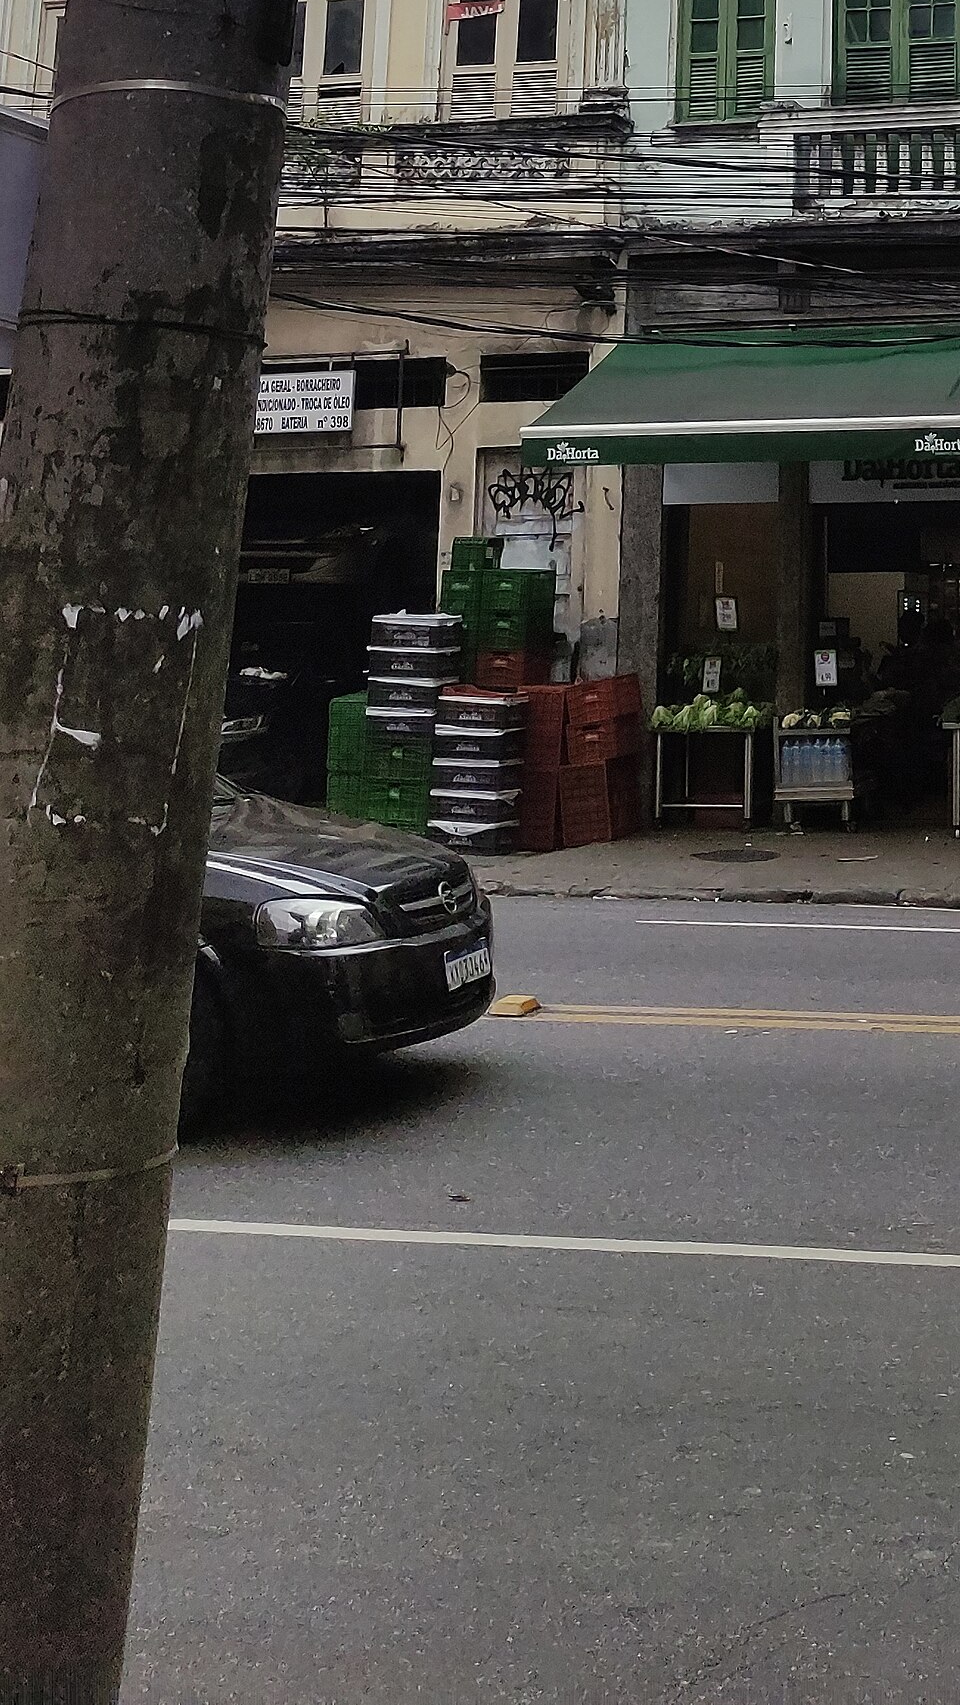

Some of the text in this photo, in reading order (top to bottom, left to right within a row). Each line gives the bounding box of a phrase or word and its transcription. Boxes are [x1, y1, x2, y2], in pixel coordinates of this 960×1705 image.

[271, 379, 291, 393] GERAL
[296, 378, 341, 392] BORRACHEIRO
[301, 398, 322, 411] TROCA
[323, 396, 332, 409] DE
[281, 416, 308, 429] BATERIA
[330, 415, 349, 428] 398
